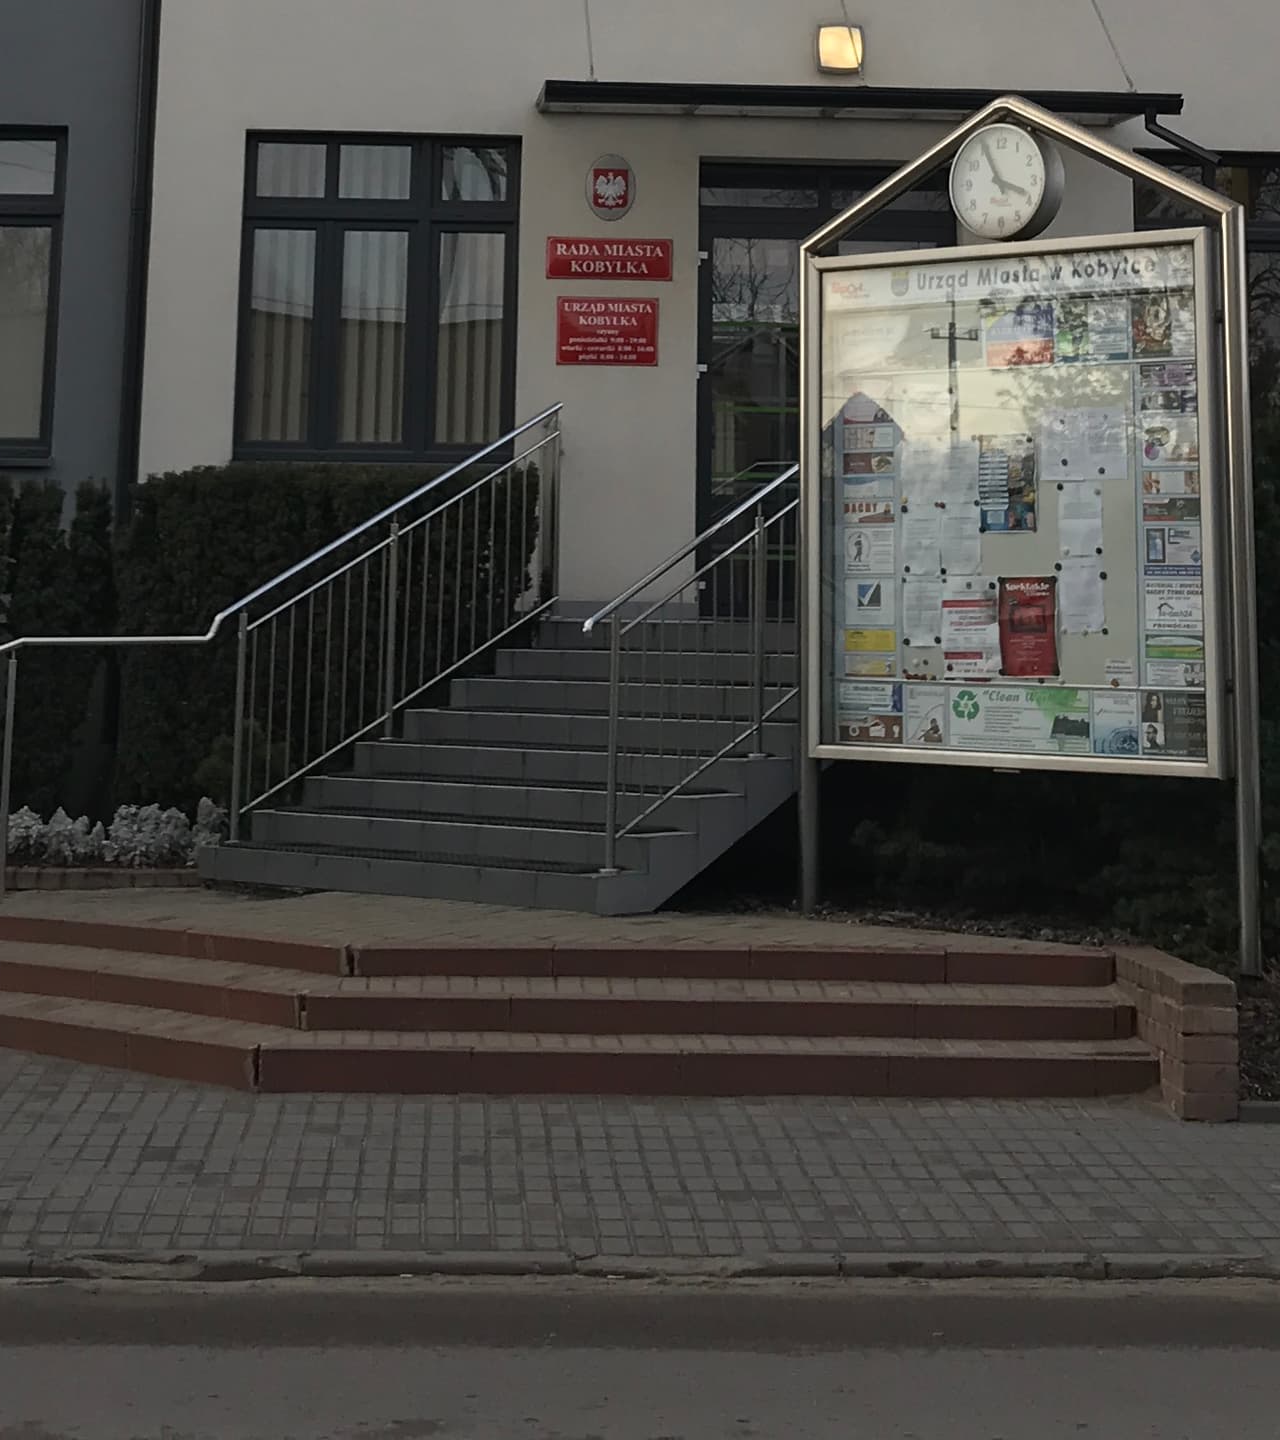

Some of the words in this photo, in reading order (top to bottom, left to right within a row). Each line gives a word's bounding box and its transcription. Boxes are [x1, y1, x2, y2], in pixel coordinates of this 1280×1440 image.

[556, 243, 600, 256] RADA
[603, 244, 664, 257] MIASTA
[977, 264, 1040, 287] Miasta
[563, 302, 605, 314] URZĄD
[607, 303, 653, 313] MIASTA
